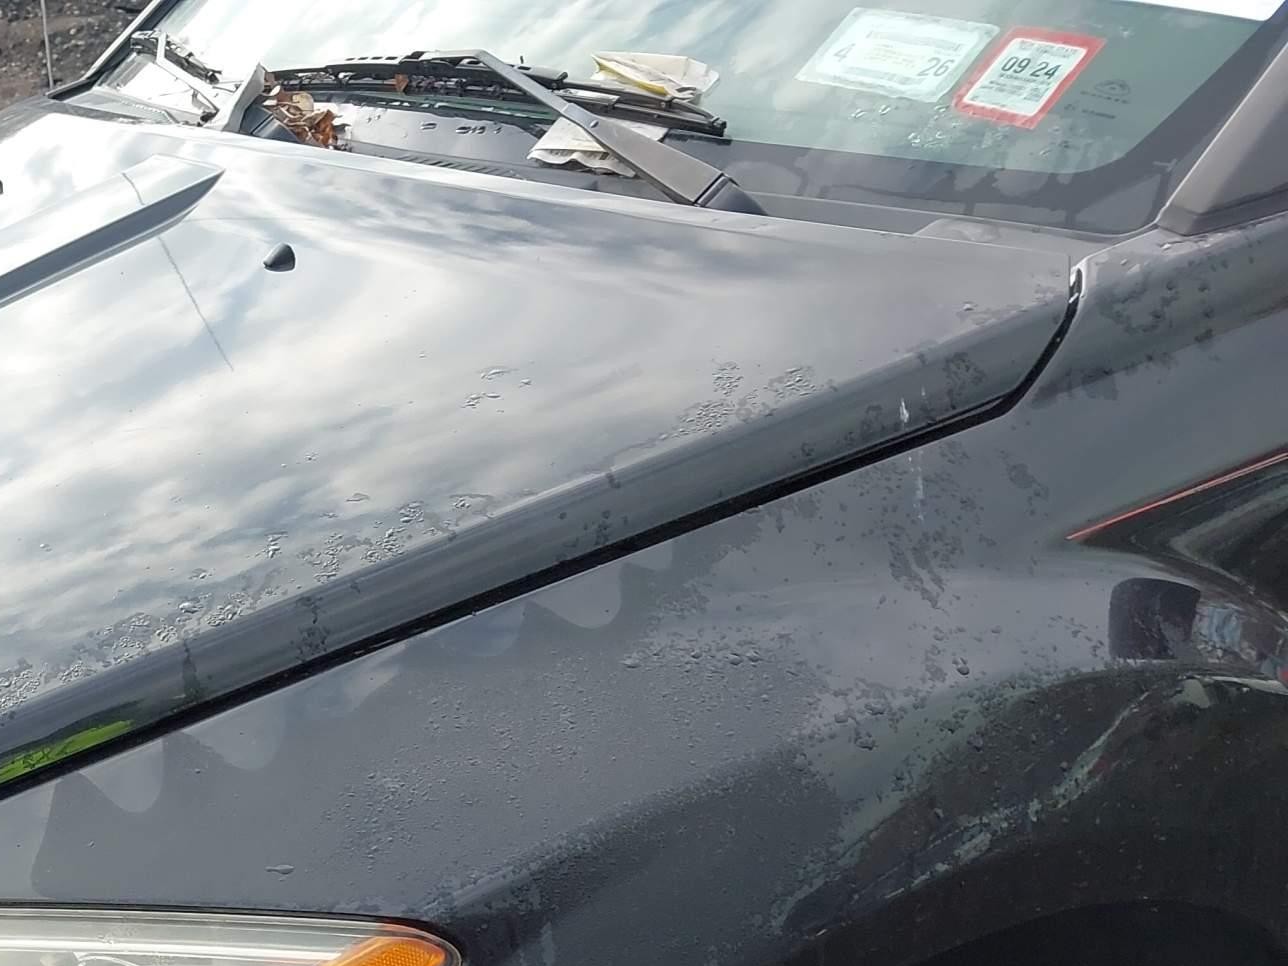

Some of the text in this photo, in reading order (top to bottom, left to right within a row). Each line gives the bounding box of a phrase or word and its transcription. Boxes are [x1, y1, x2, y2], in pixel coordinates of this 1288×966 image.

[832, 43, 856, 62] 4
[916, 57, 955, 78] 26
[1001, 56, 1031, 74] 09
[1030, 61, 1061, 80] 24
